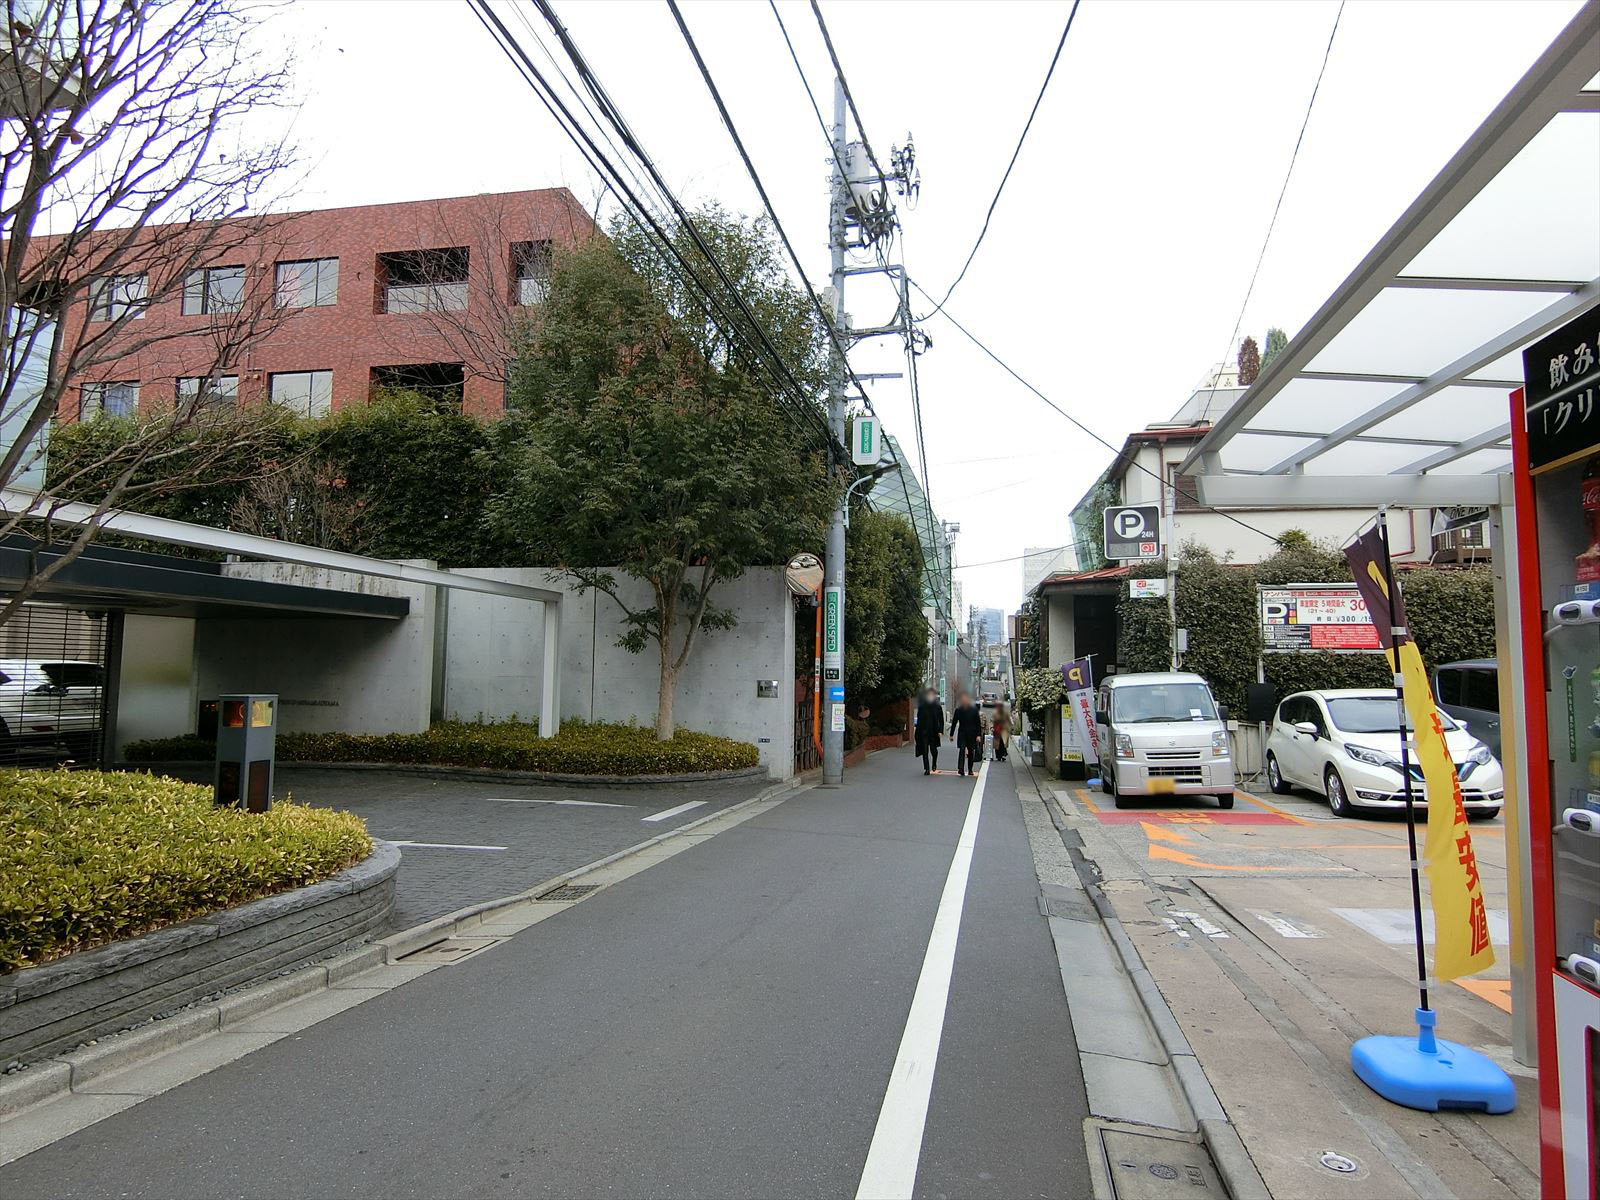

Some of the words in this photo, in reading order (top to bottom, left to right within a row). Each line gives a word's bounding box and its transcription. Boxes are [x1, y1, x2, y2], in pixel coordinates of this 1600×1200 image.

[1548, 334, 1600, 390] 飲み
[1543, 386, 1600, 436] 「クリ
[1120, 514, 1141, 536] P
[1141, 530, 1154, 539] 24H
[827, 602, 836, 628] GREEN
